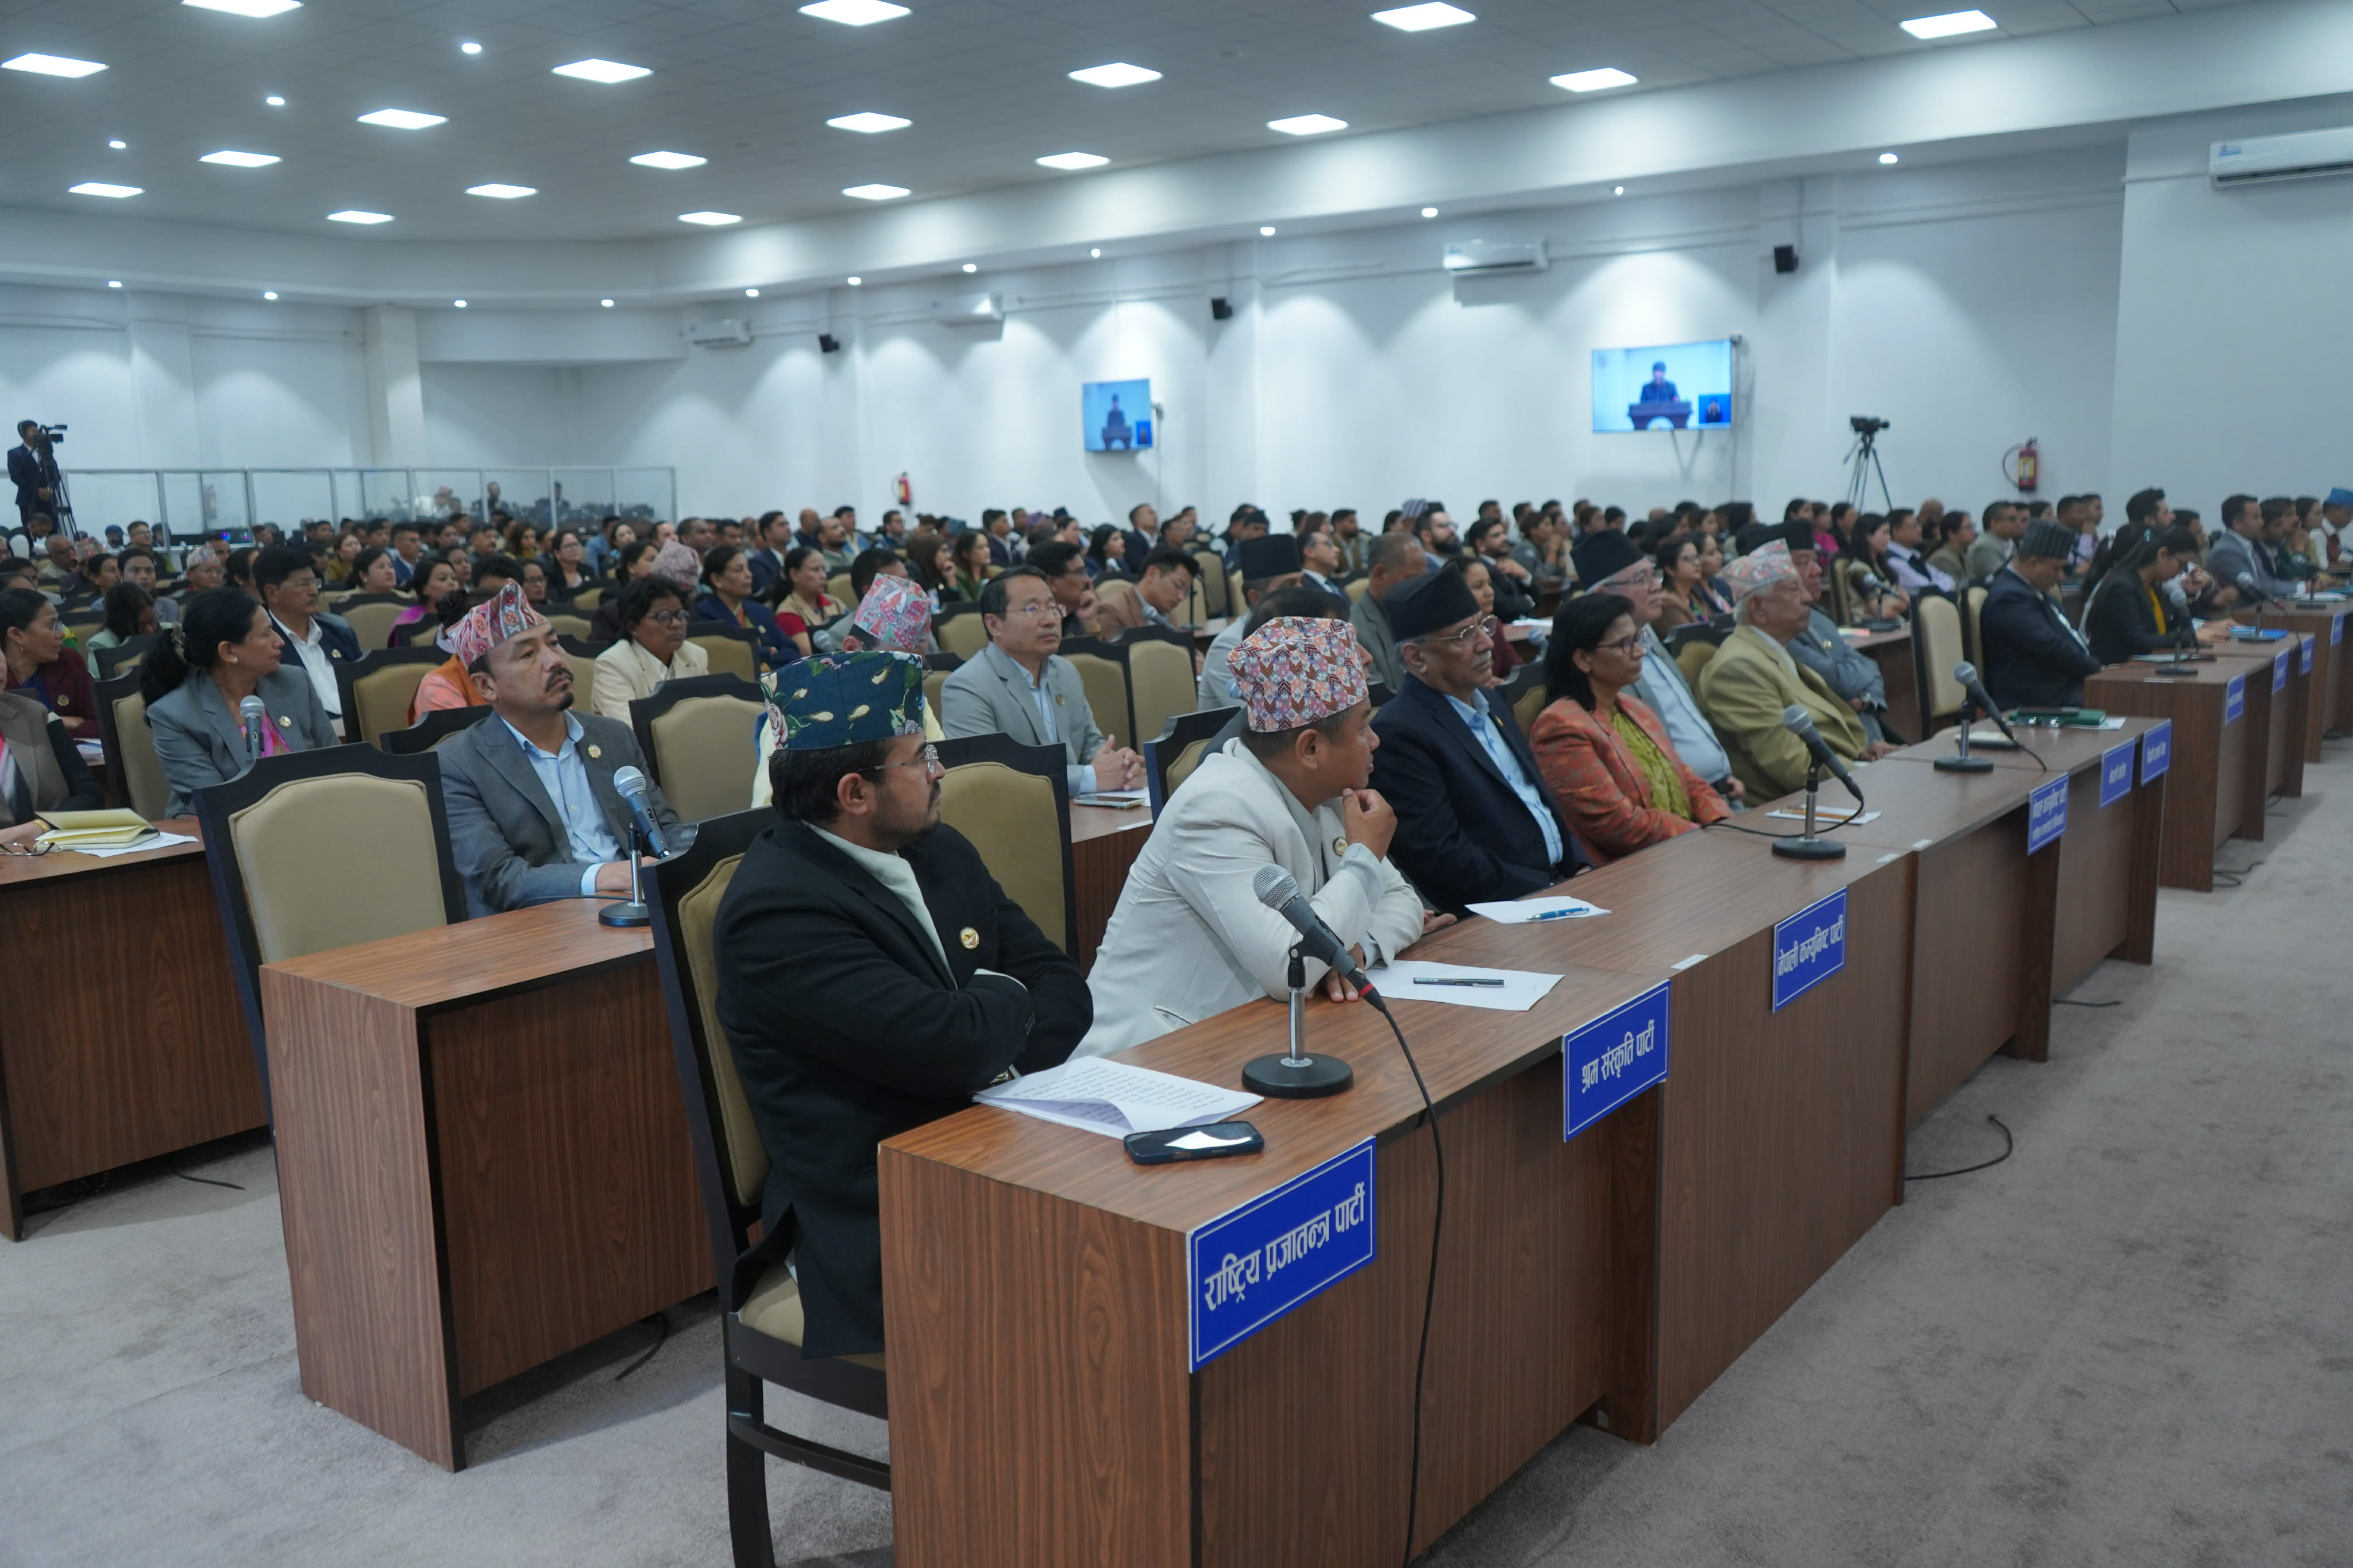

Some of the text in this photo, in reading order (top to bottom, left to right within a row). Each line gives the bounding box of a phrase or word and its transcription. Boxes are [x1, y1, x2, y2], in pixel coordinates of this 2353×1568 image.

[1582, 1019, 1654, 1093] श्रम संस्कृति पार्टी
[1205, 1181, 1365, 1311] राष्ट्रिय प्रजातन्त्र पार्टी
